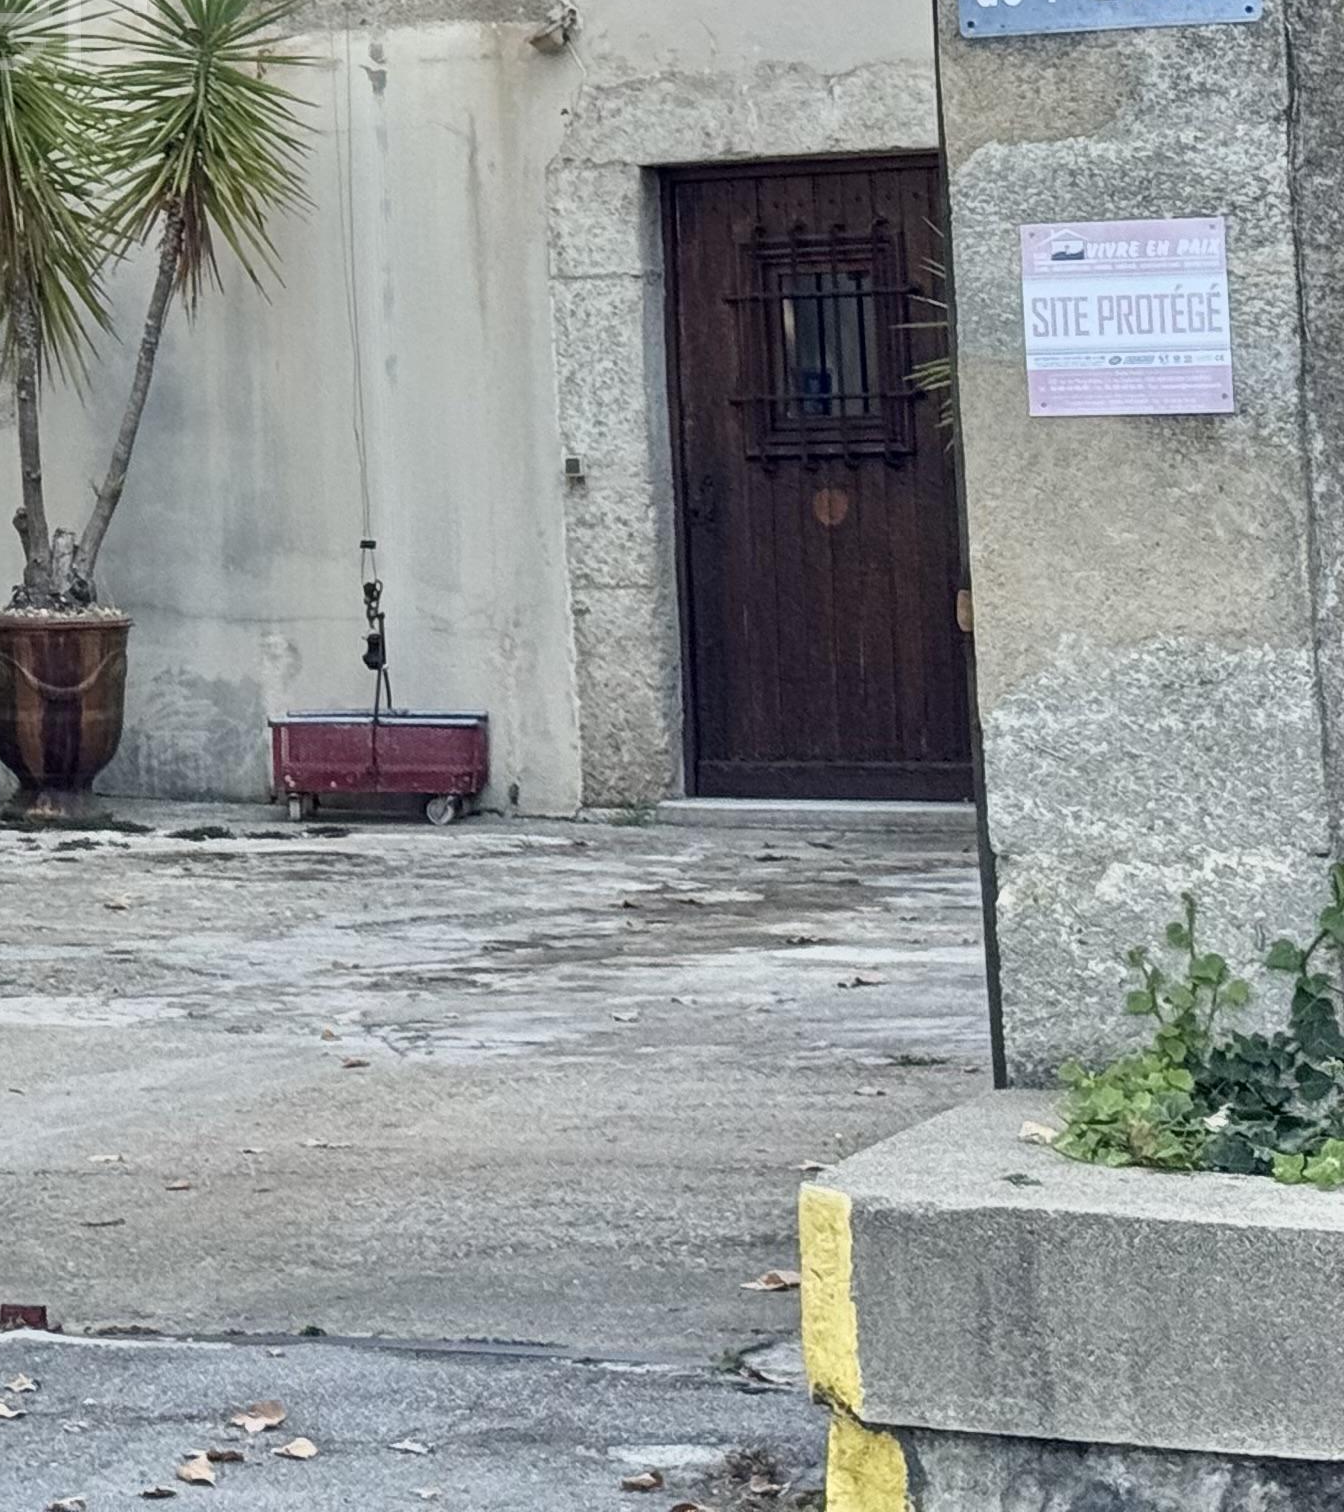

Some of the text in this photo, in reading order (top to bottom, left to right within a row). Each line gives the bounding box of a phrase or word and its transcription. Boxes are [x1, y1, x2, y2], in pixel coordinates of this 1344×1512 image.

[1086, 238, 1221, 259] VIVRE EN PAIX
[1031, 283, 1224, 338] SITE PROTÉGÉ
